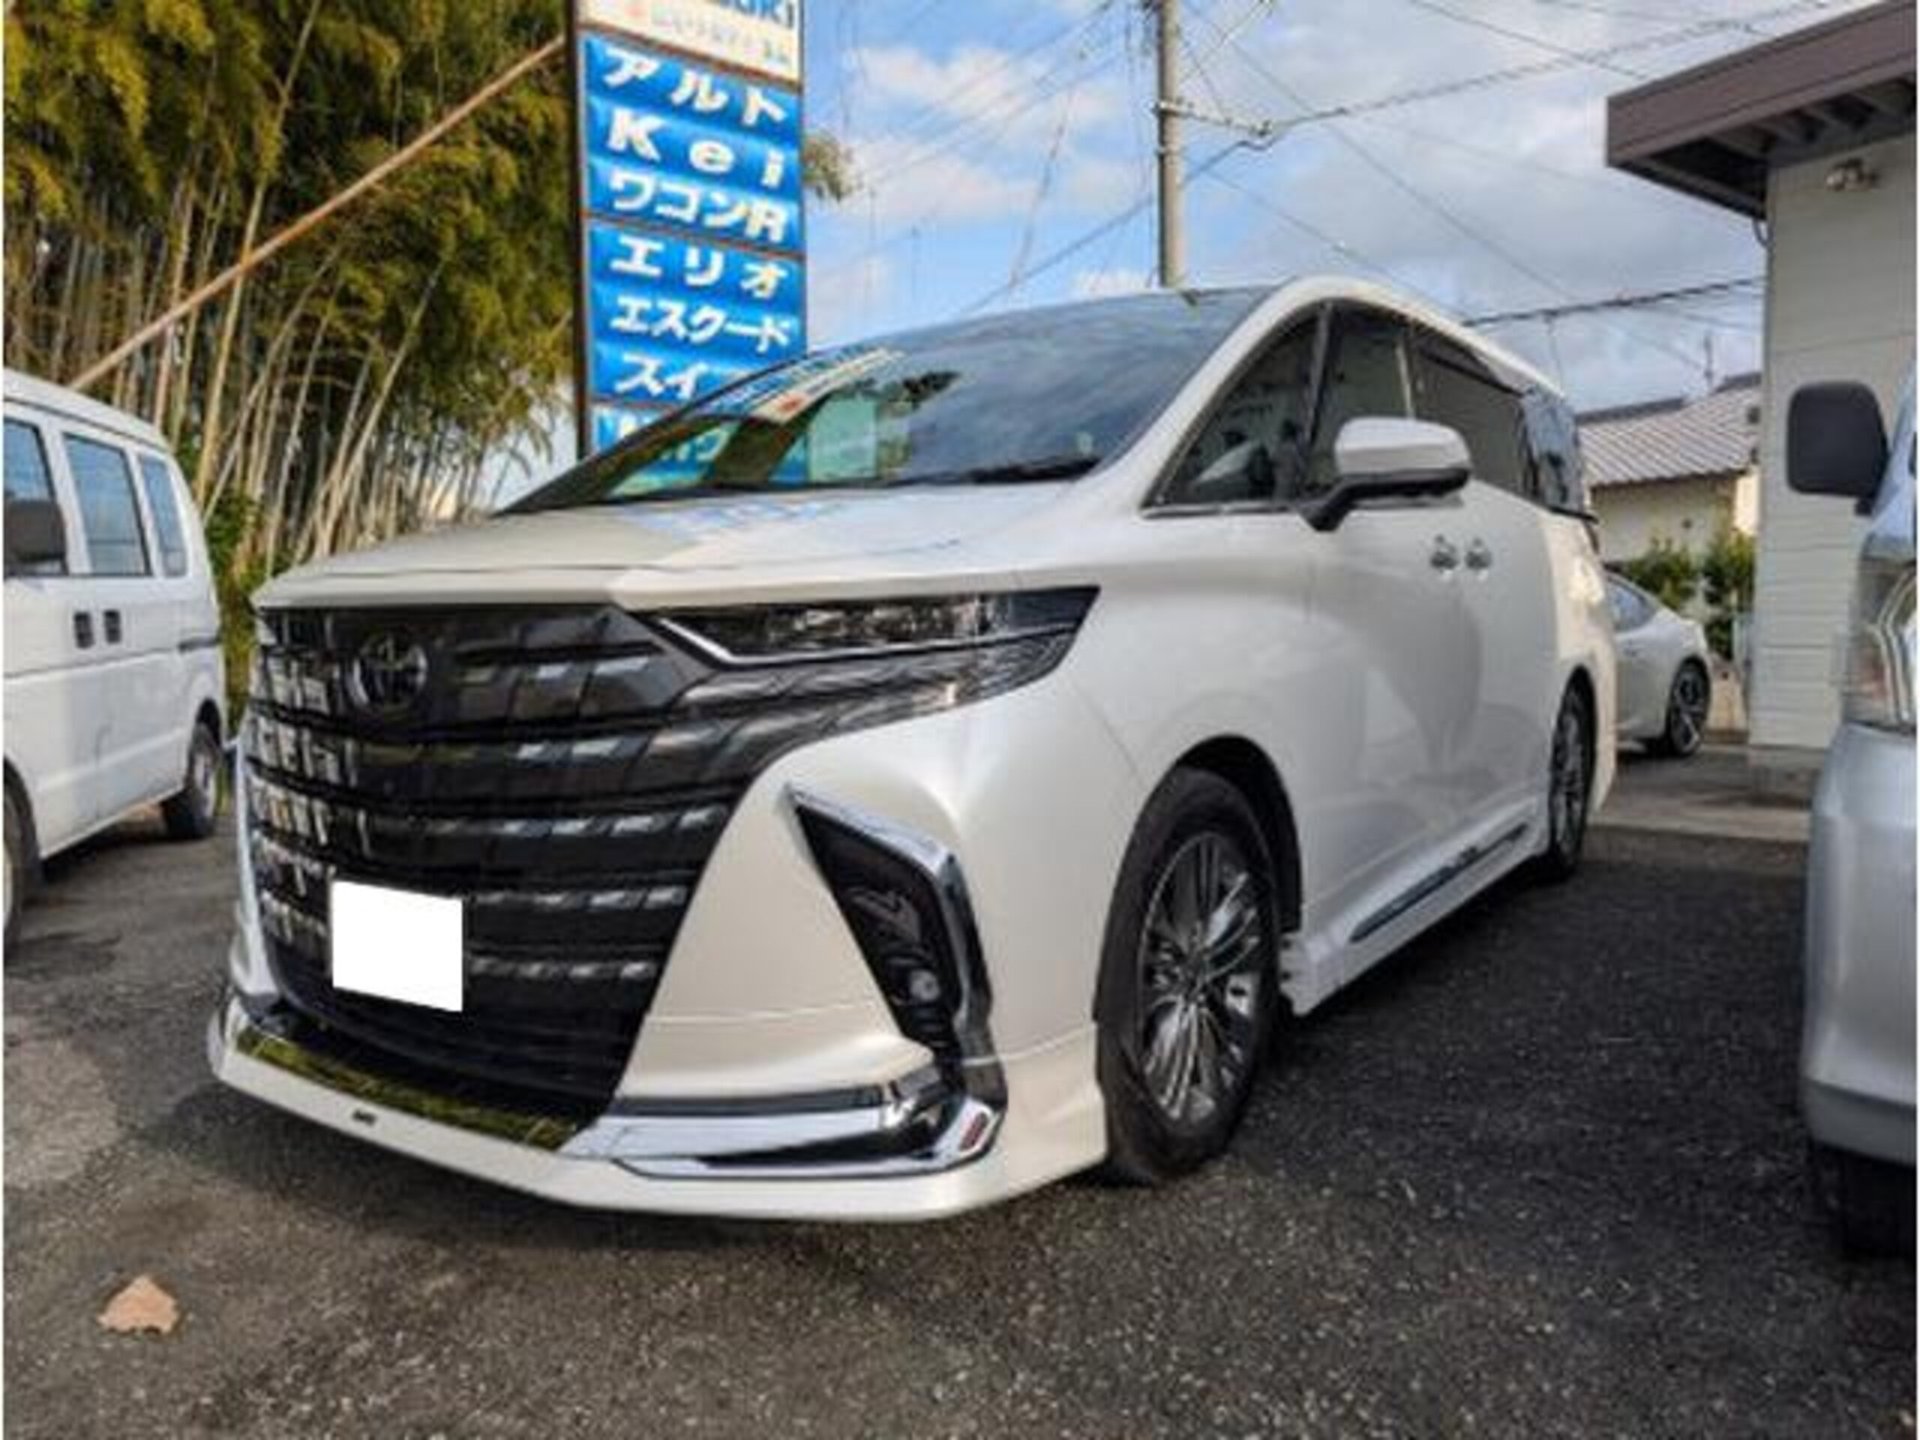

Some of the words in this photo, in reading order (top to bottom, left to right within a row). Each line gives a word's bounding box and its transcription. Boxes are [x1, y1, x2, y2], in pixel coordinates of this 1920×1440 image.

[602, 46, 788, 126] アルト
[606, 106, 784, 189] Kei
[609, 234, 789, 299] エリオ
[609, 295, 792, 353] エスクード
[614, 352, 708, 399] スイ
